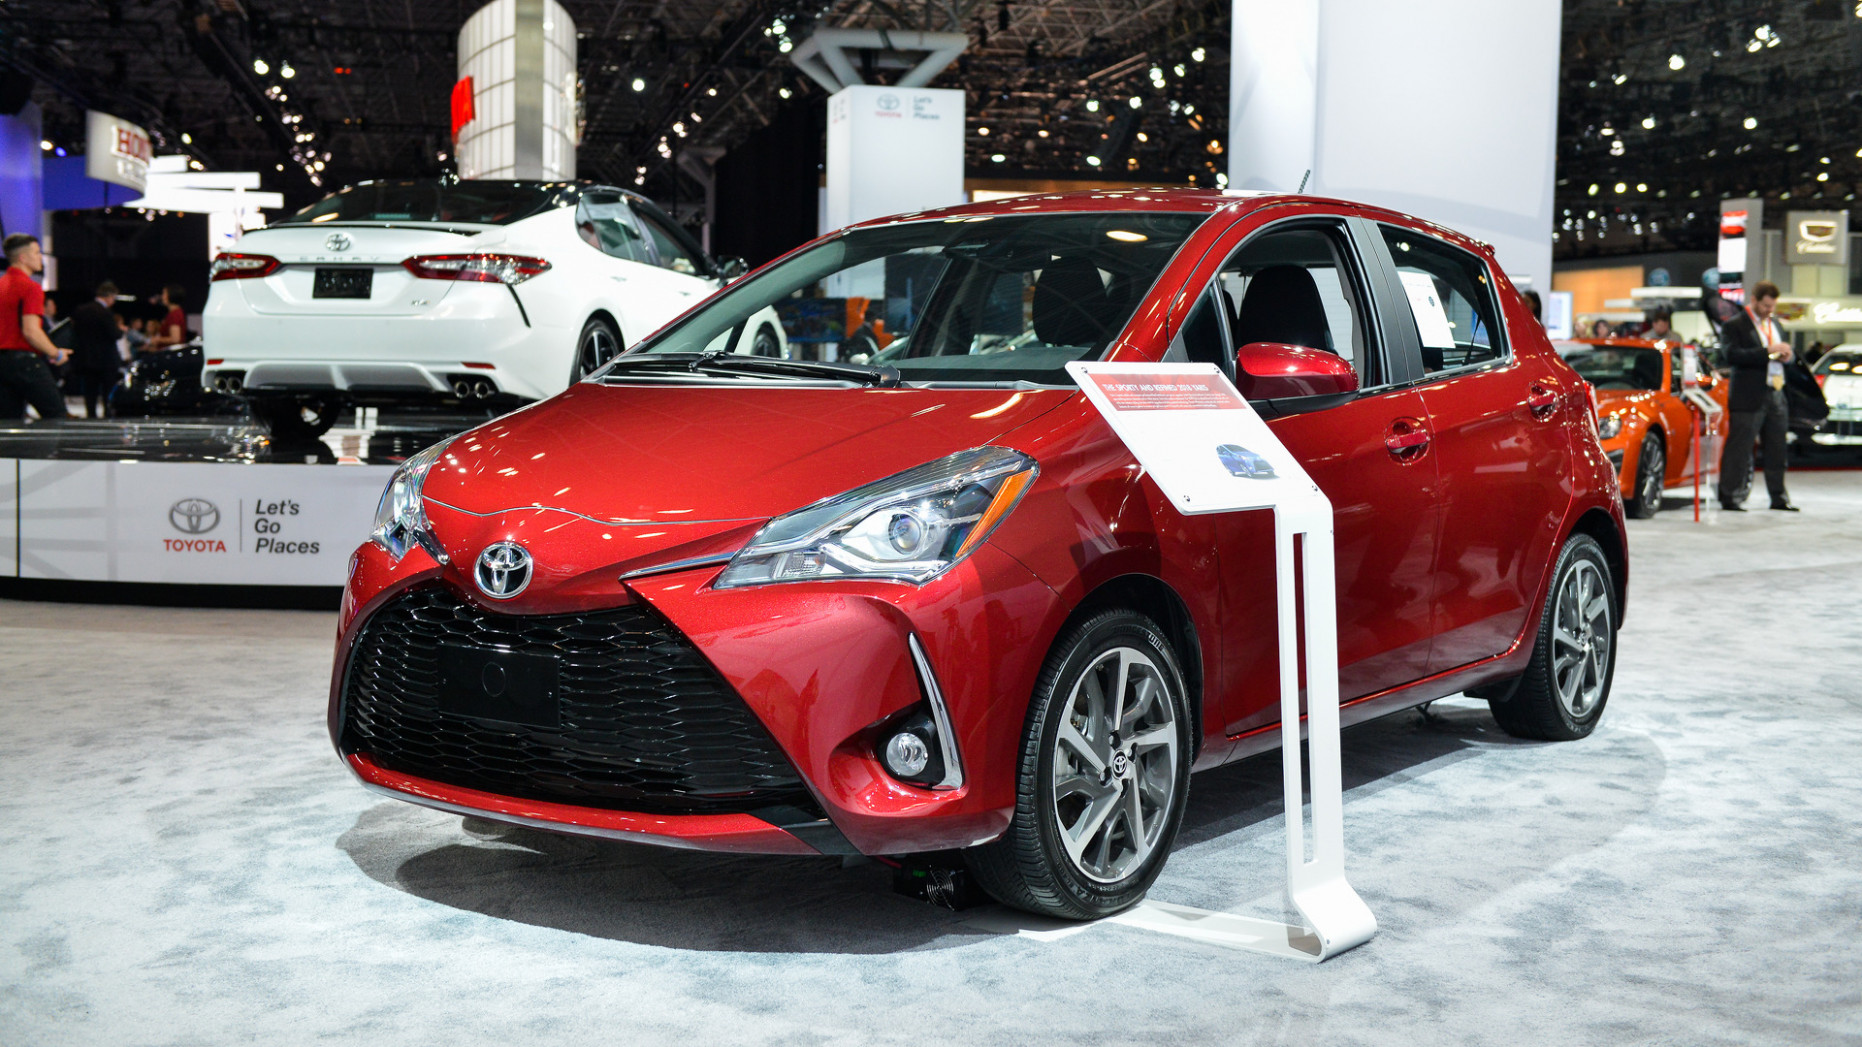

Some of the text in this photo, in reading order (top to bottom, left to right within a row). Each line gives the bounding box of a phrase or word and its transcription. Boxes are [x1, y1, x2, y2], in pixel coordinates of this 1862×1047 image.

[255, 499, 300, 516] Let's
[254, 517, 281, 534] Go
[163, 539, 227, 553] TOYOTA
[255, 537, 320, 554] Places
